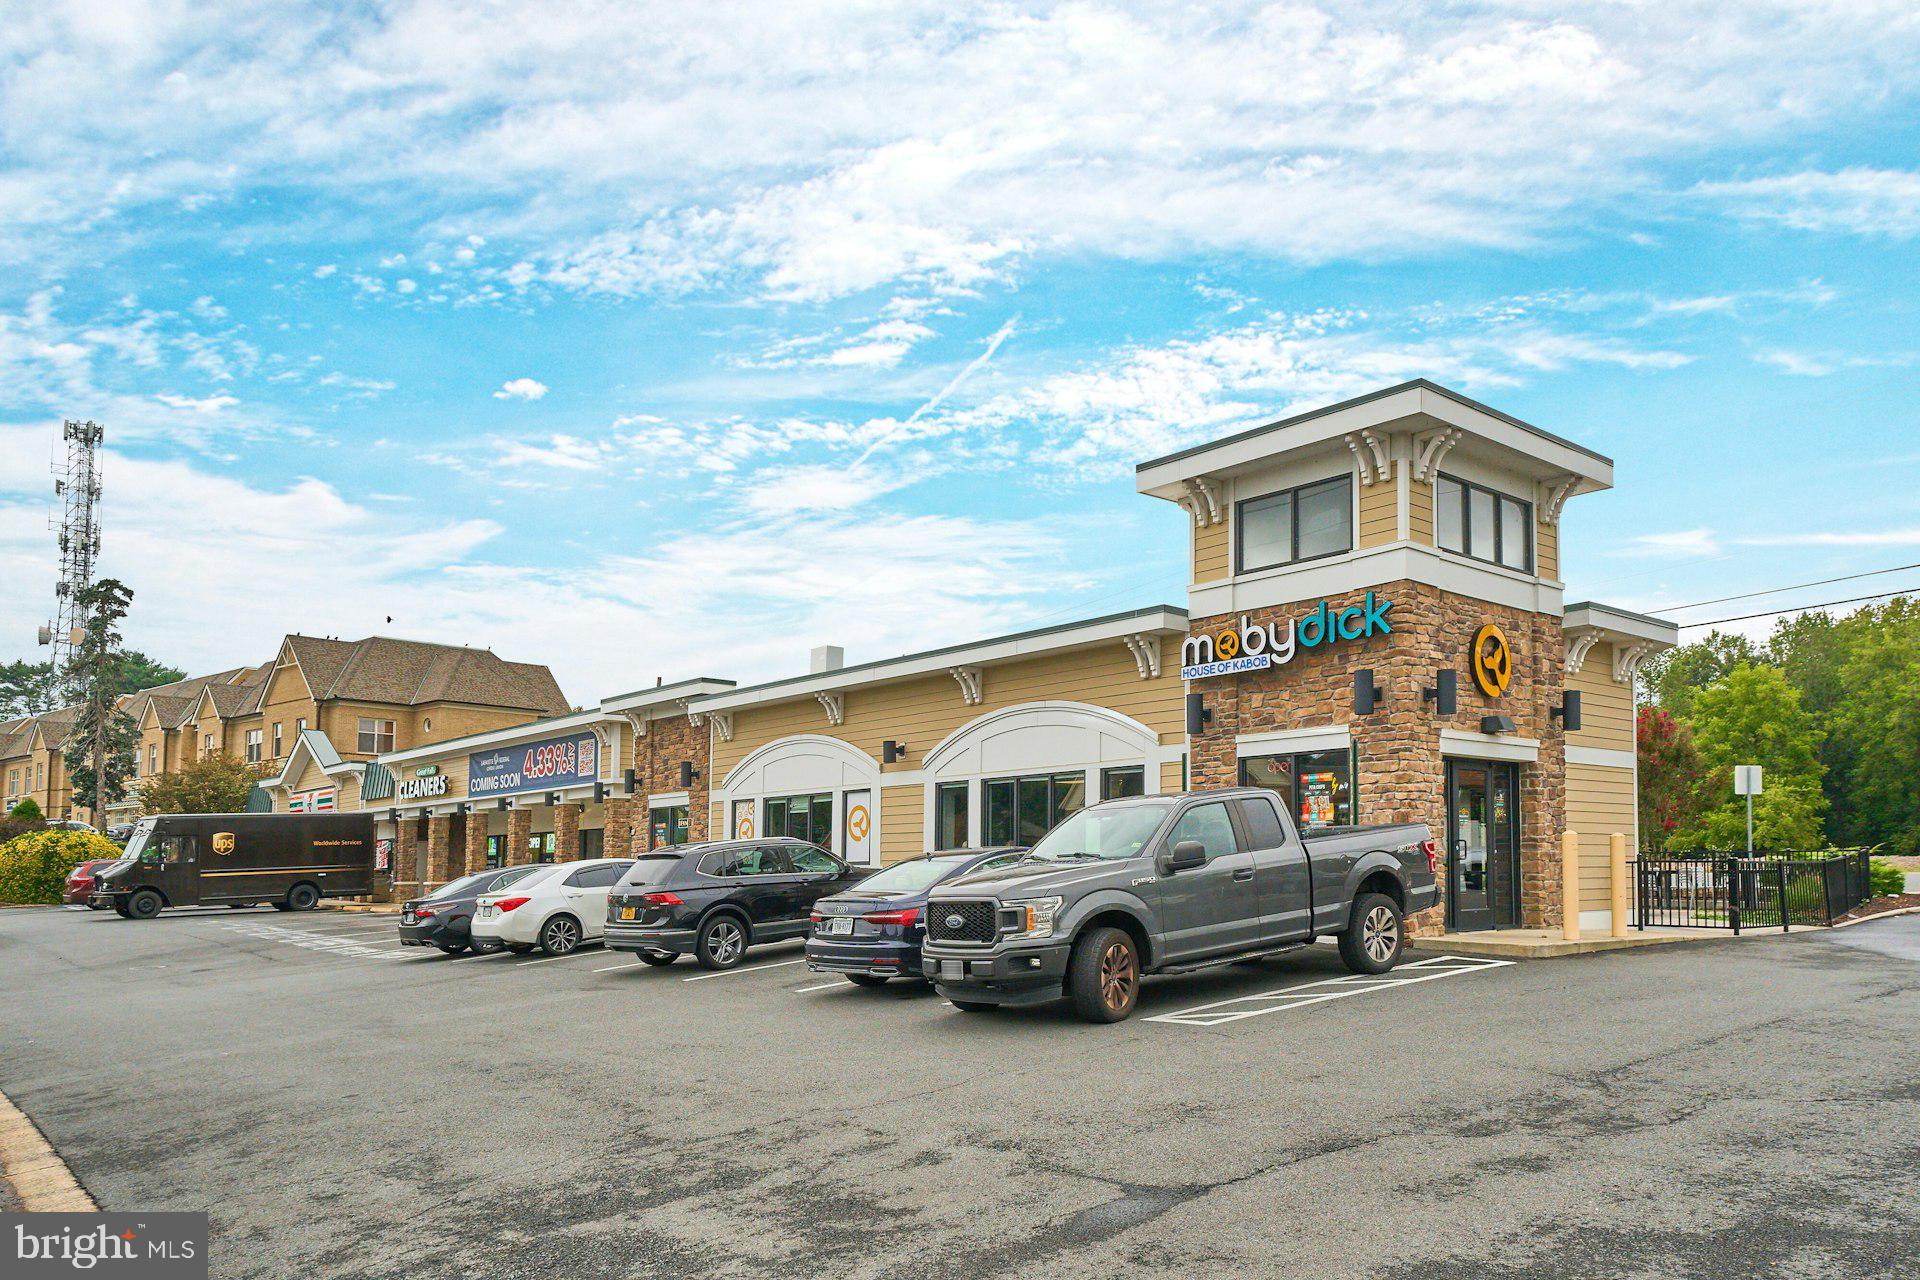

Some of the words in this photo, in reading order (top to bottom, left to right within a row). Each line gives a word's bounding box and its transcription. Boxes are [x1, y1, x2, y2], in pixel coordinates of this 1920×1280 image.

[1182, 663, 1216, 679] HOUSE
[1217, 661, 1232, 673] OF
[1232, 656, 1269, 671] KABOB
[523, 743, 568, 779] 4.33%
[399, 775, 447, 799] CLEANERS
[470, 775, 499, 792] COMING
[499, 772, 521, 788] SOON
[214, 838, 233, 852] ups
